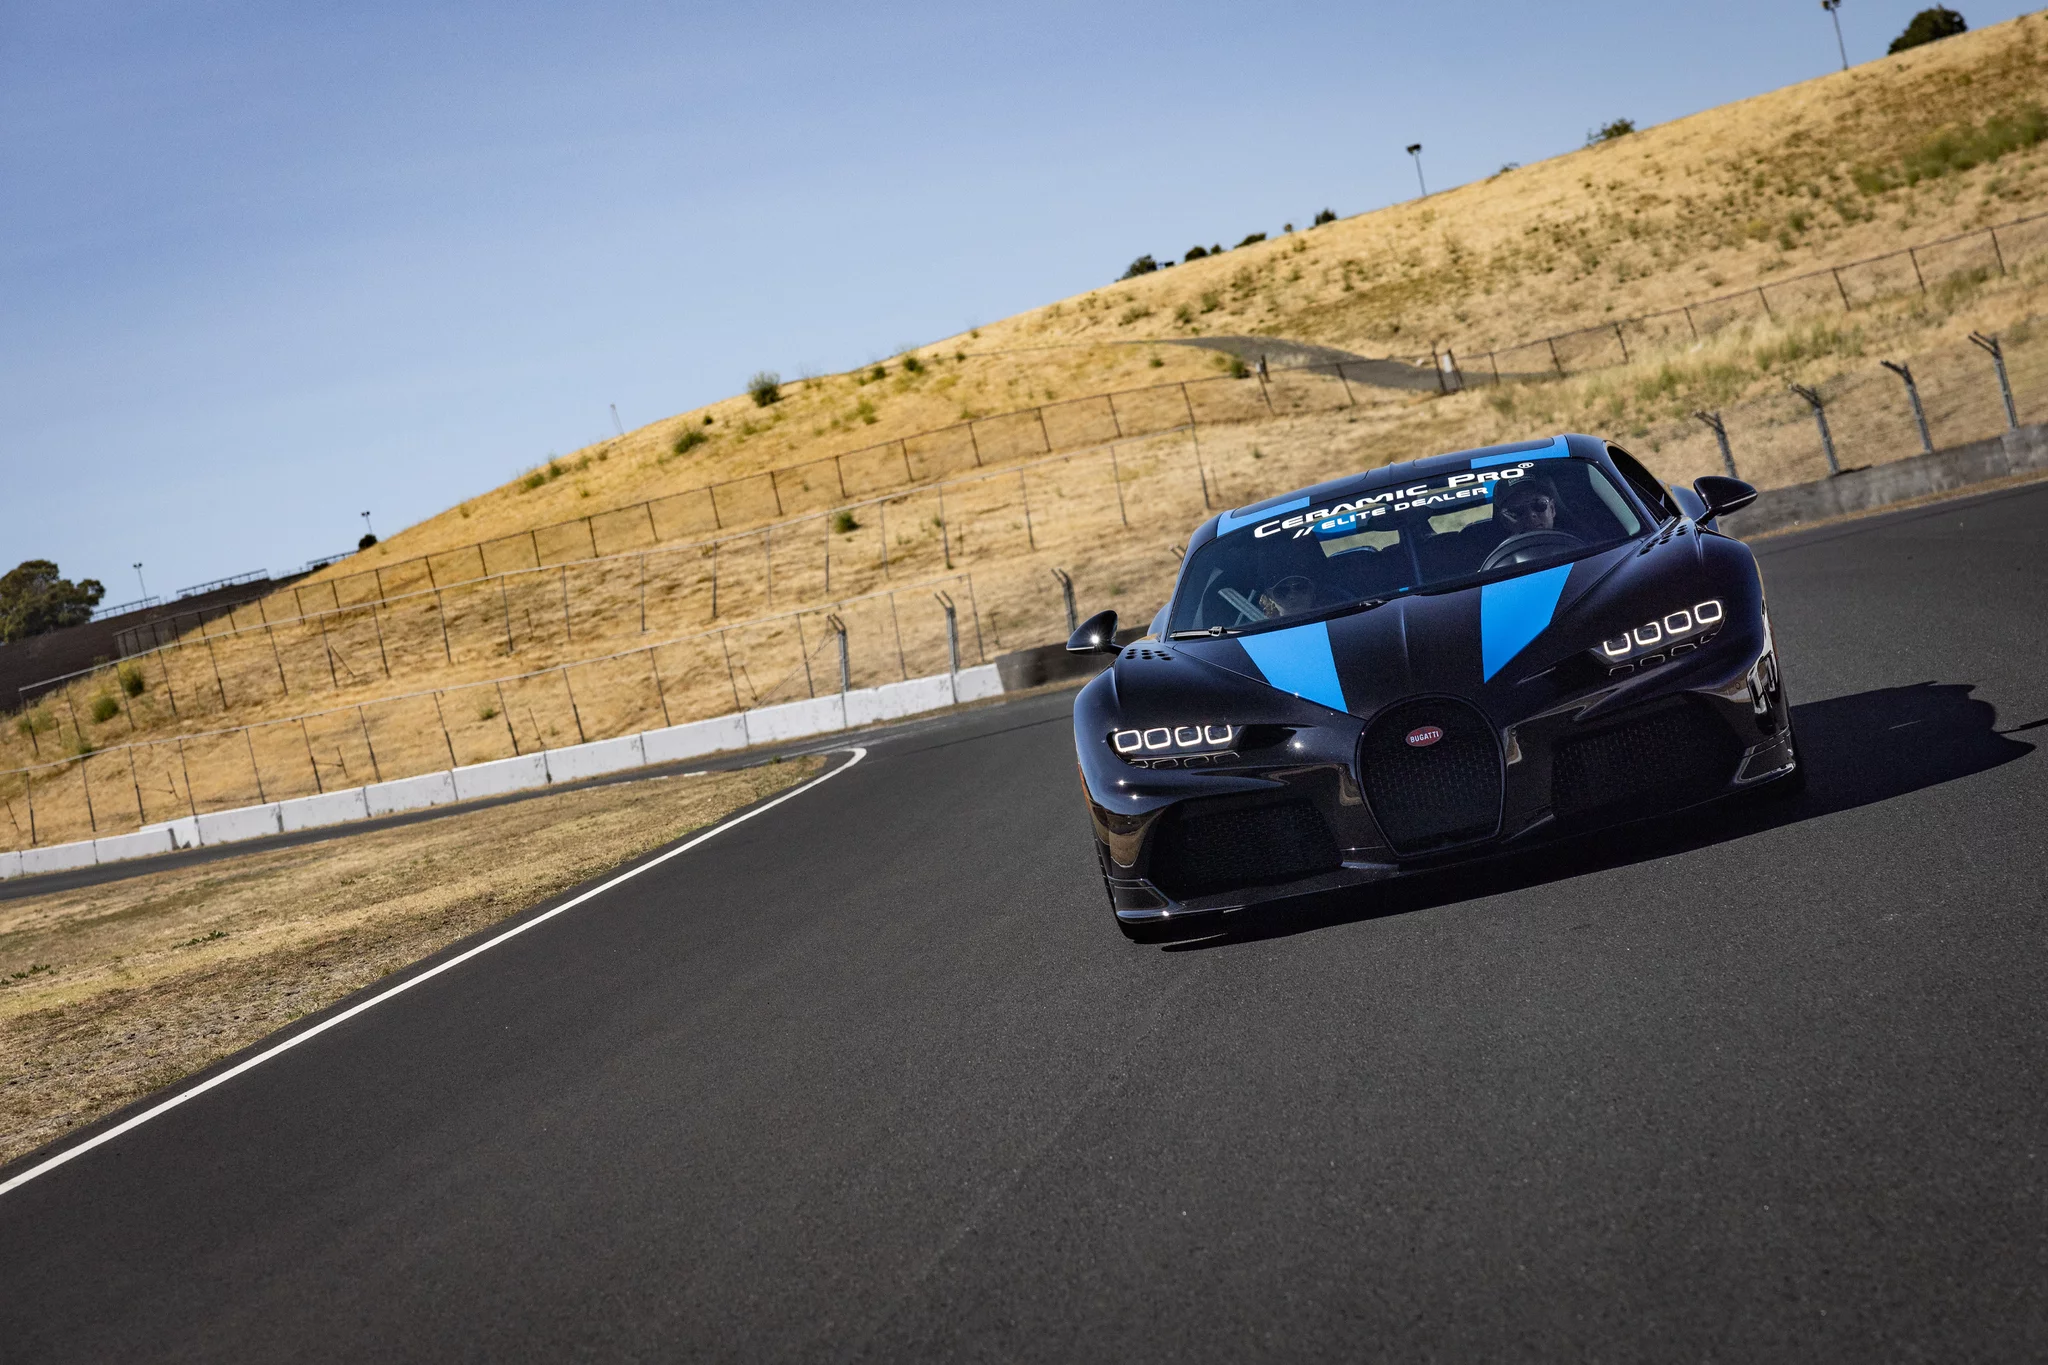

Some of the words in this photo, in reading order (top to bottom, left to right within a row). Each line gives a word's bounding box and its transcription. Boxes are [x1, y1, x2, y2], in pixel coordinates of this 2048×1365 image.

[1253, 484, 1428, 539] CERAMIC
[1321, 507, 1387, 530] ELITE
[1394, 486, 1489, 512] DEALER
[1410, 730, 1440, 743] BUGATTI
